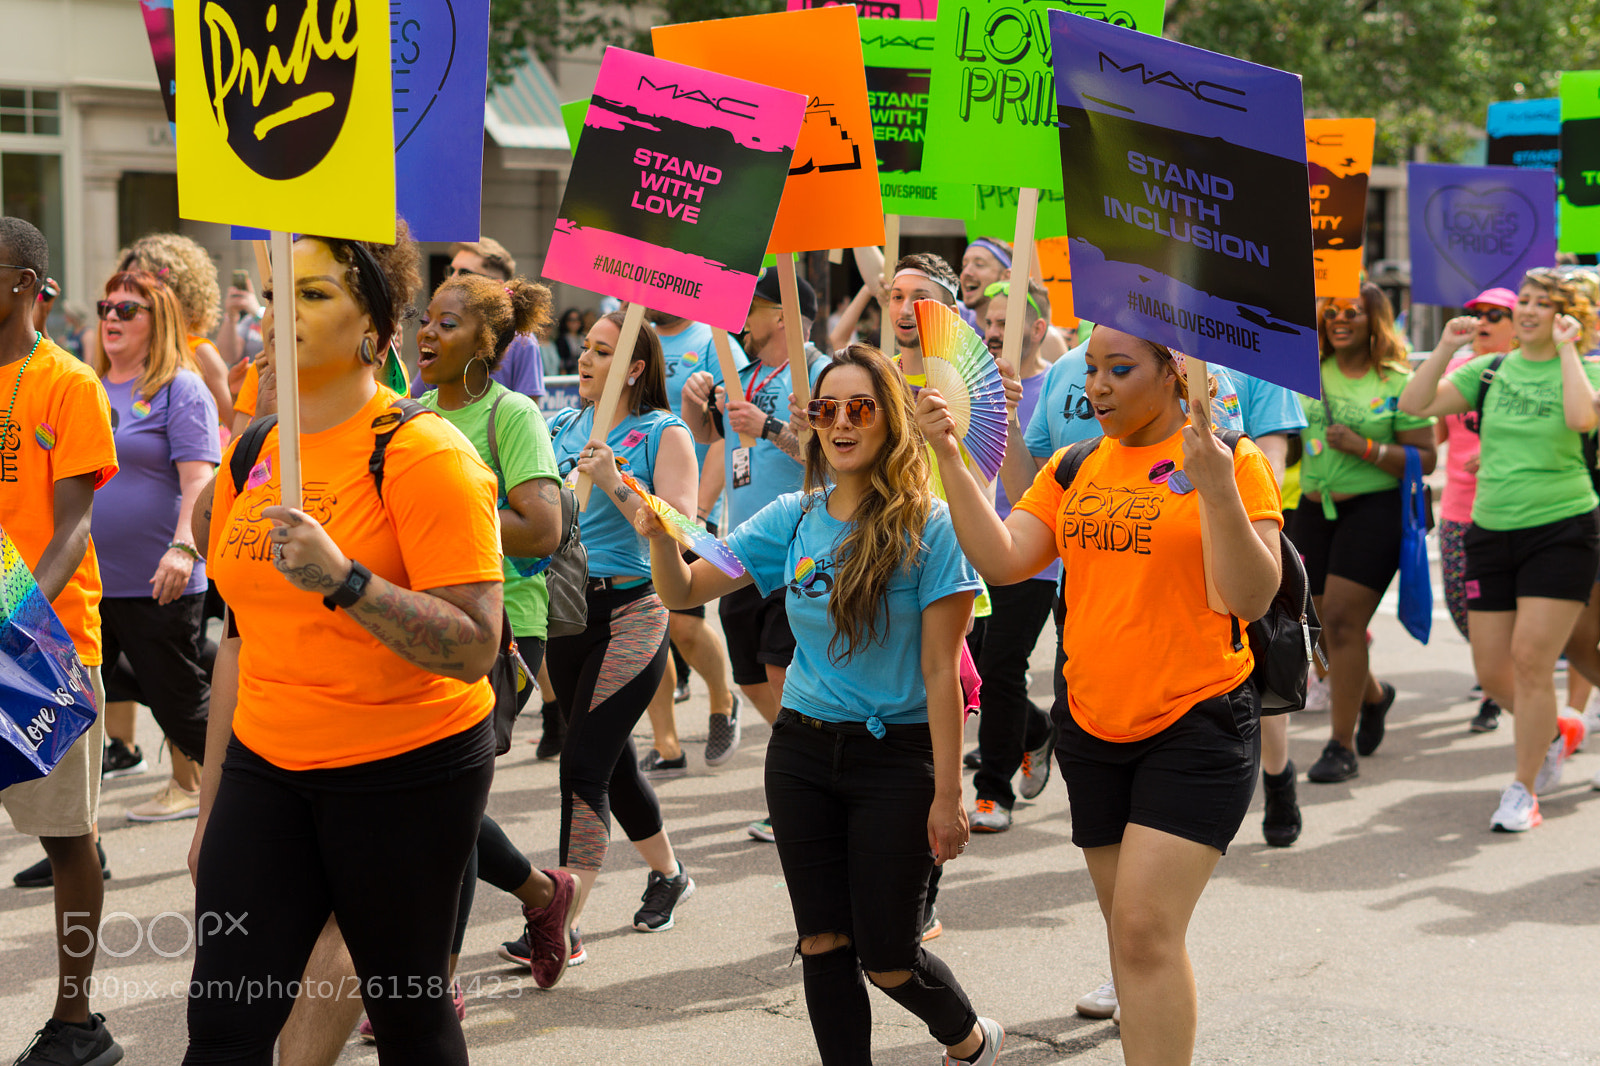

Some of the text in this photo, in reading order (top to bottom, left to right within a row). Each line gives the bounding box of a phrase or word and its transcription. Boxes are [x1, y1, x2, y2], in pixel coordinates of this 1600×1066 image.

[203, 0, 358, 141] Pride
[868, 90, 930, 109] STAND
[959, 66, 1059, 126] PRI
[871, 108, 922, 126] WITH
[873, 126, 926, 143] ERAN
[633, 147, 723, 185] STAND
[1127, 151, 1235, 201] STAND
[641, 170, 705, 204] WITH
[881, 183, 938, 200] LOVESPRIDE
[1142, 181, 1221, 226] WITH
[630, 190, 701, 225] LOVE
[1443, 210, 1519, 235] LOVES
[1103, 196, 1270, 268] INCLUSION
[1448, 231, 1514, 256] PRIDE
[593, 254, 703, 299] #MACLOVESPRIDE
[1127, 290, 1261, 352] #MACLOVESPRIDE
[539, 390, 579, 410] Police
[1494, 396, 1553, 418] PRIDE
[234, 492, 337, 526] LOES
[1063, 489, 1164, 521] LOVES
[221, 524, 276, 561] PRI
[1061, 517, 1152, 555] PRIDE
[12, 687, 75, 752] Love is
